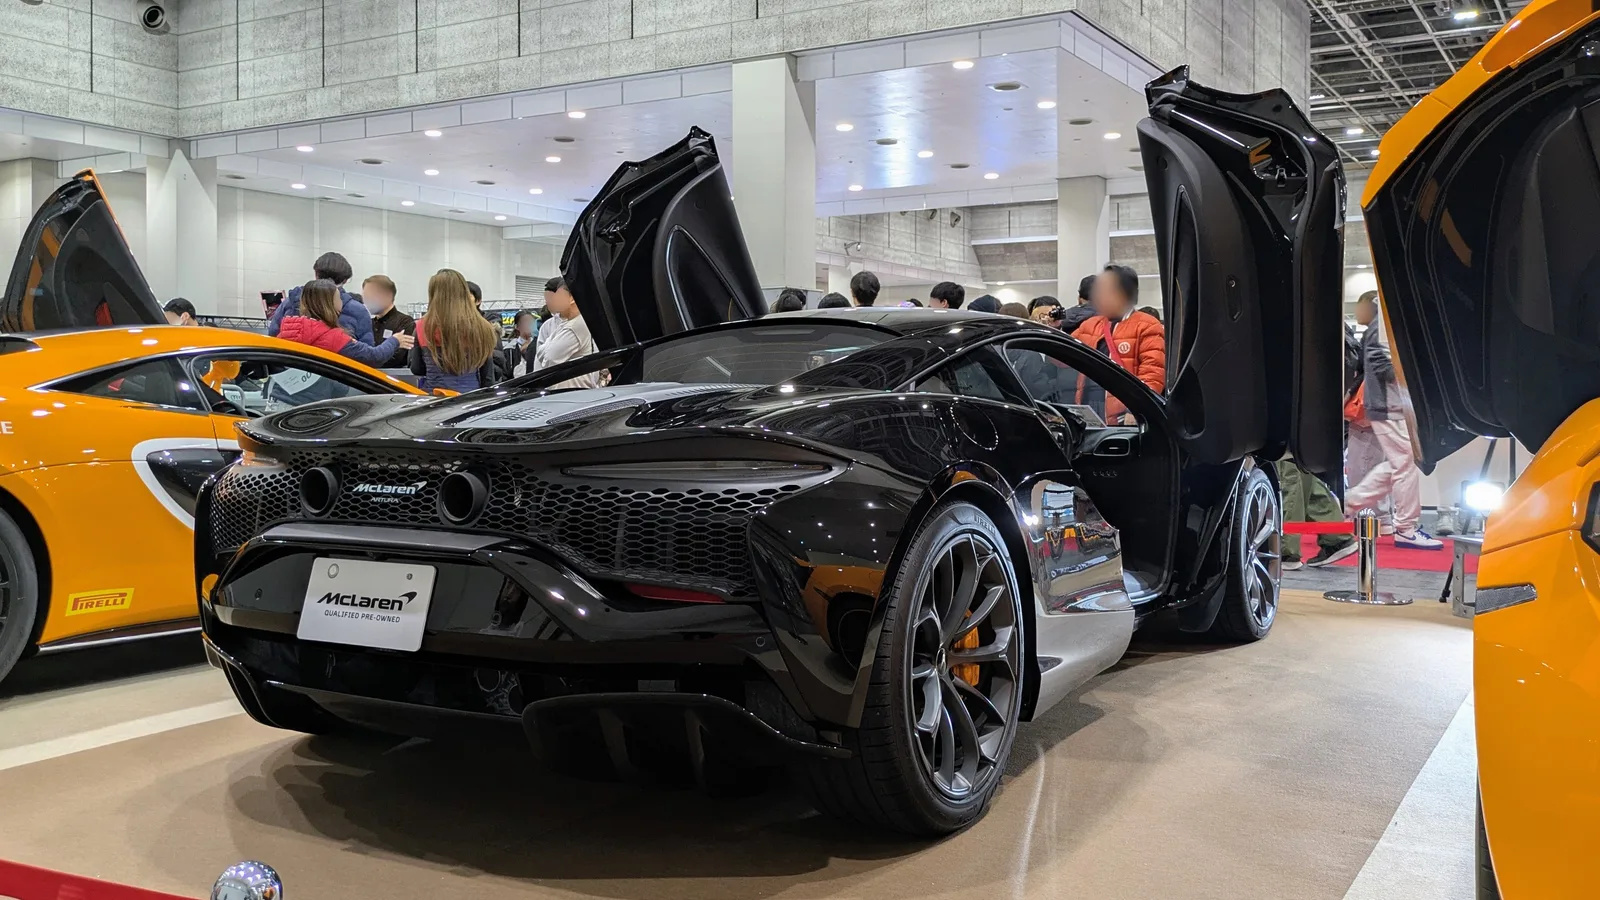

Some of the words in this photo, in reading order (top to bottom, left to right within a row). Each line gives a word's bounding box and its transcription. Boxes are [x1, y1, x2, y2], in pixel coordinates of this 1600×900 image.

[352, 483, 417, 494] McLaren
[71, 592, 127, 611] PIRELLI
[317, 592, 403, 611] McLaren
[324, 609, 359, 619] QUALIFIED
[361, 613, 401, 623] PRE-OWNED
